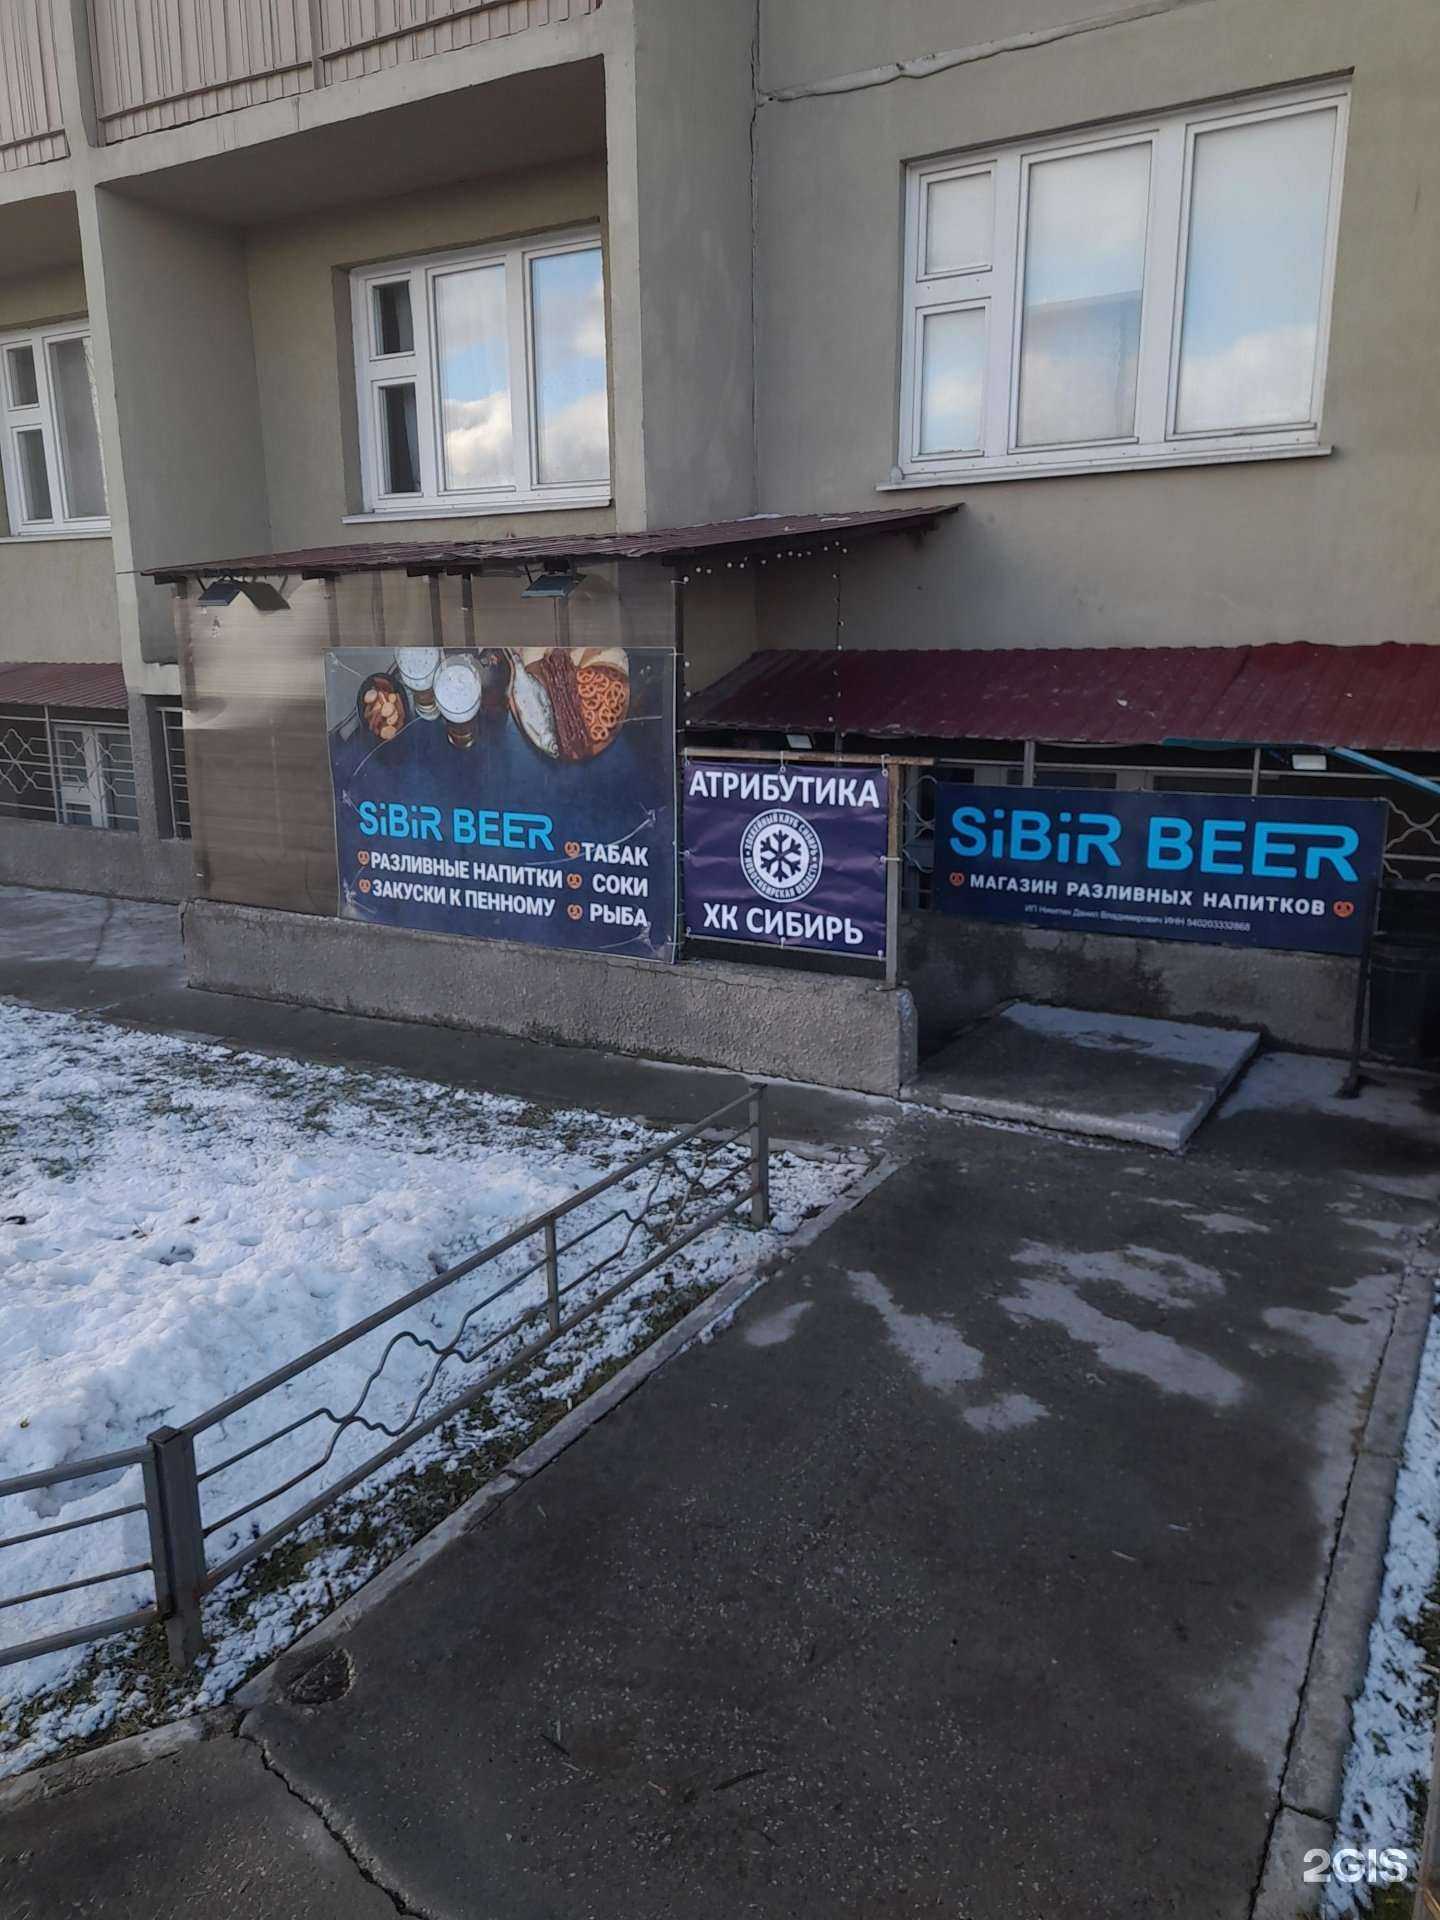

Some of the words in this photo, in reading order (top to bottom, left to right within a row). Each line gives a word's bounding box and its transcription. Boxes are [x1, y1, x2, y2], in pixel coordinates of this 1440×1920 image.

[689, 770, 880, 808] АТРИБУТИКА
[359, 800, 443, 841] SiBiR
[453, 808, 554, 851] BEER
[778, 813, 800, 829] КЛУБ
[581, 842, 649, 867] ТАБАК
[949, 806, 1122, 867] SiBiR
[1147, 816, 1359, 882] BEER
[371, 851, 470, 879] РАЗЛИВНЫЕ
[473, 863, 563, 889] НАПИТКИ
[592, 873, 649, 897] СОКИ
[372, 880, 447, 905] ЗАКУСКИ
[450, 889, 462, 906] К
[465, 890, 556, 918] ПЕННОМУ
[970, 873, 1058, 896] МАГАЗИН
[1066, 881, 1193, 906] РАЗЛИВНЫХ
[1202, 891, 1326, 917] НАПИТКОВ
[589, 903, 648, 928] РЫБА
[703, 902, 738, 931] ХК
[746, 907, 864, 945] СИБИРЬ
[1024, 904, 1037, 913] ИП
[1164, 915, 1185, 926] ИНН
